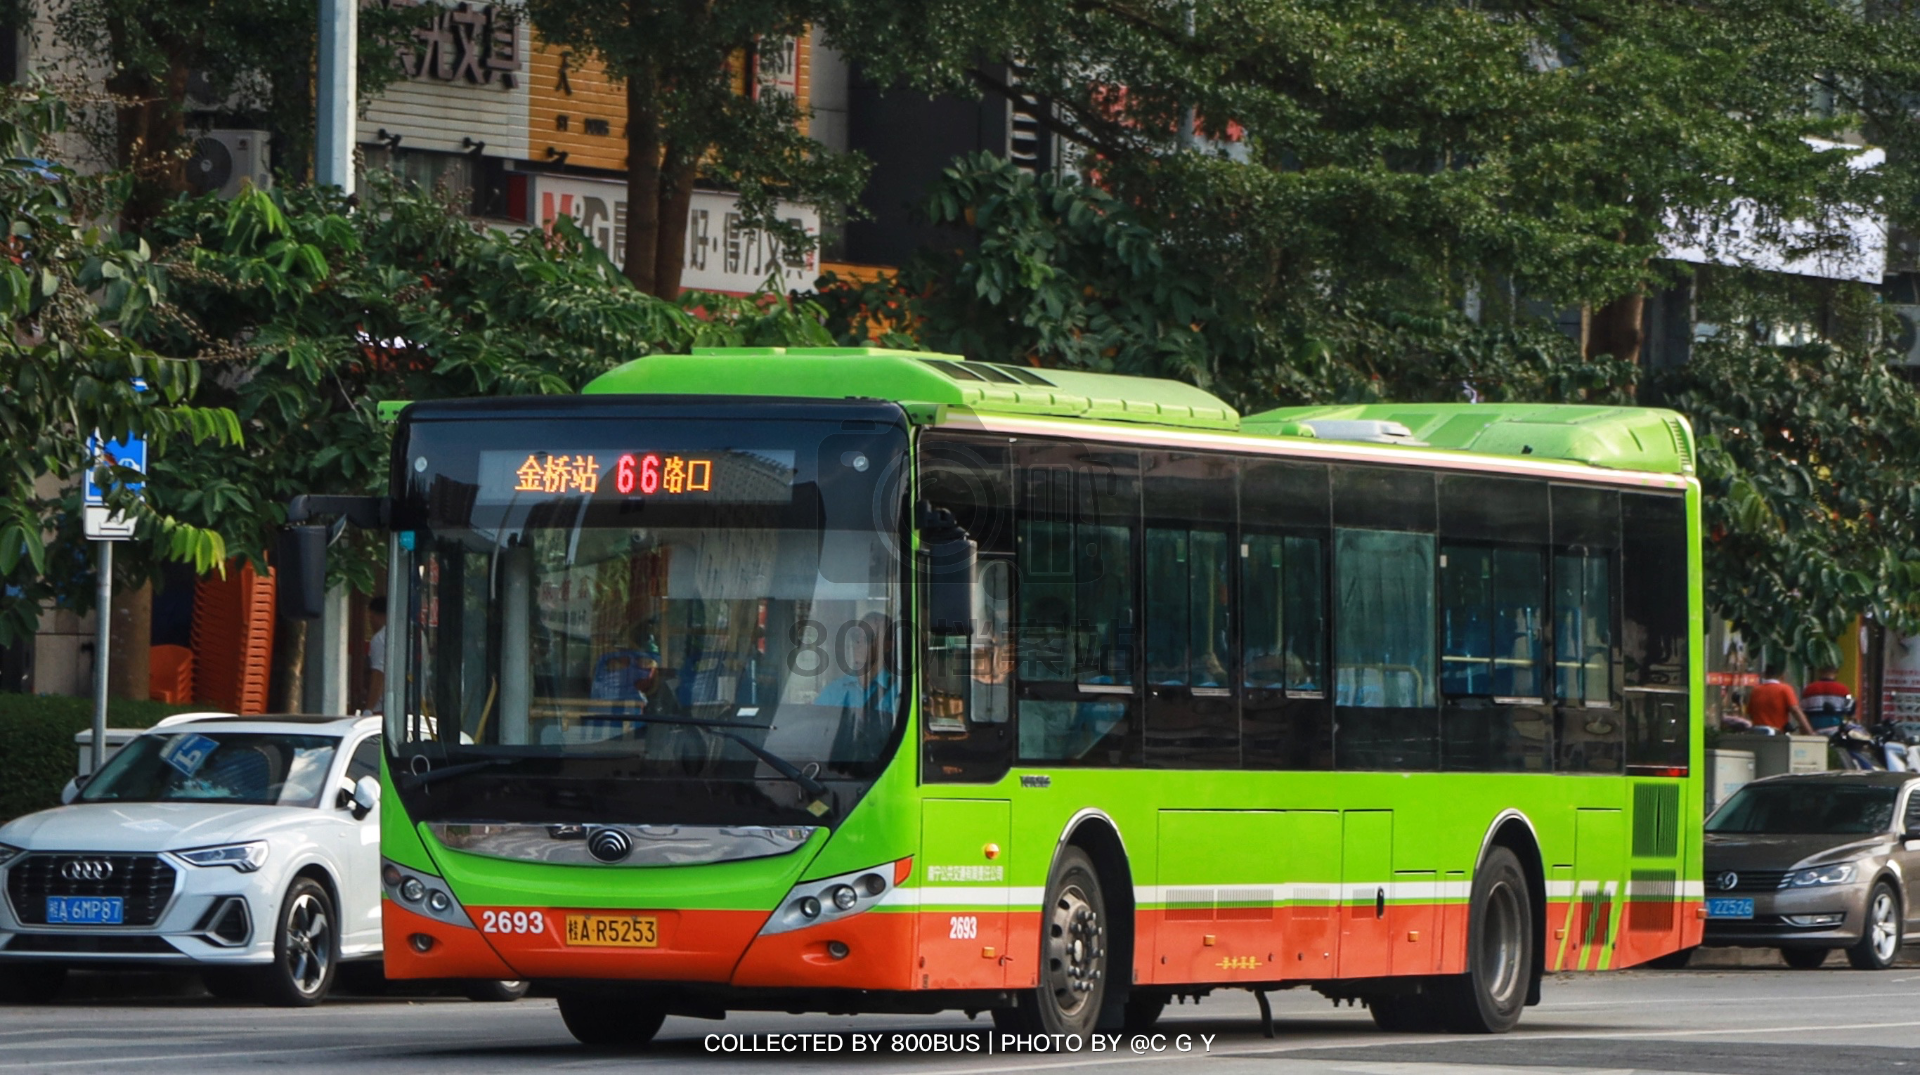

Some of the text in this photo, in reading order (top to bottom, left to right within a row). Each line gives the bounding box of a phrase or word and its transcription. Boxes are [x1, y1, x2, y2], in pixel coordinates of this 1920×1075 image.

[514, 455, 600, 493] 金桥站
[482, 910, 544, 934] 2693
[949, 916, 978, 940] 2693
